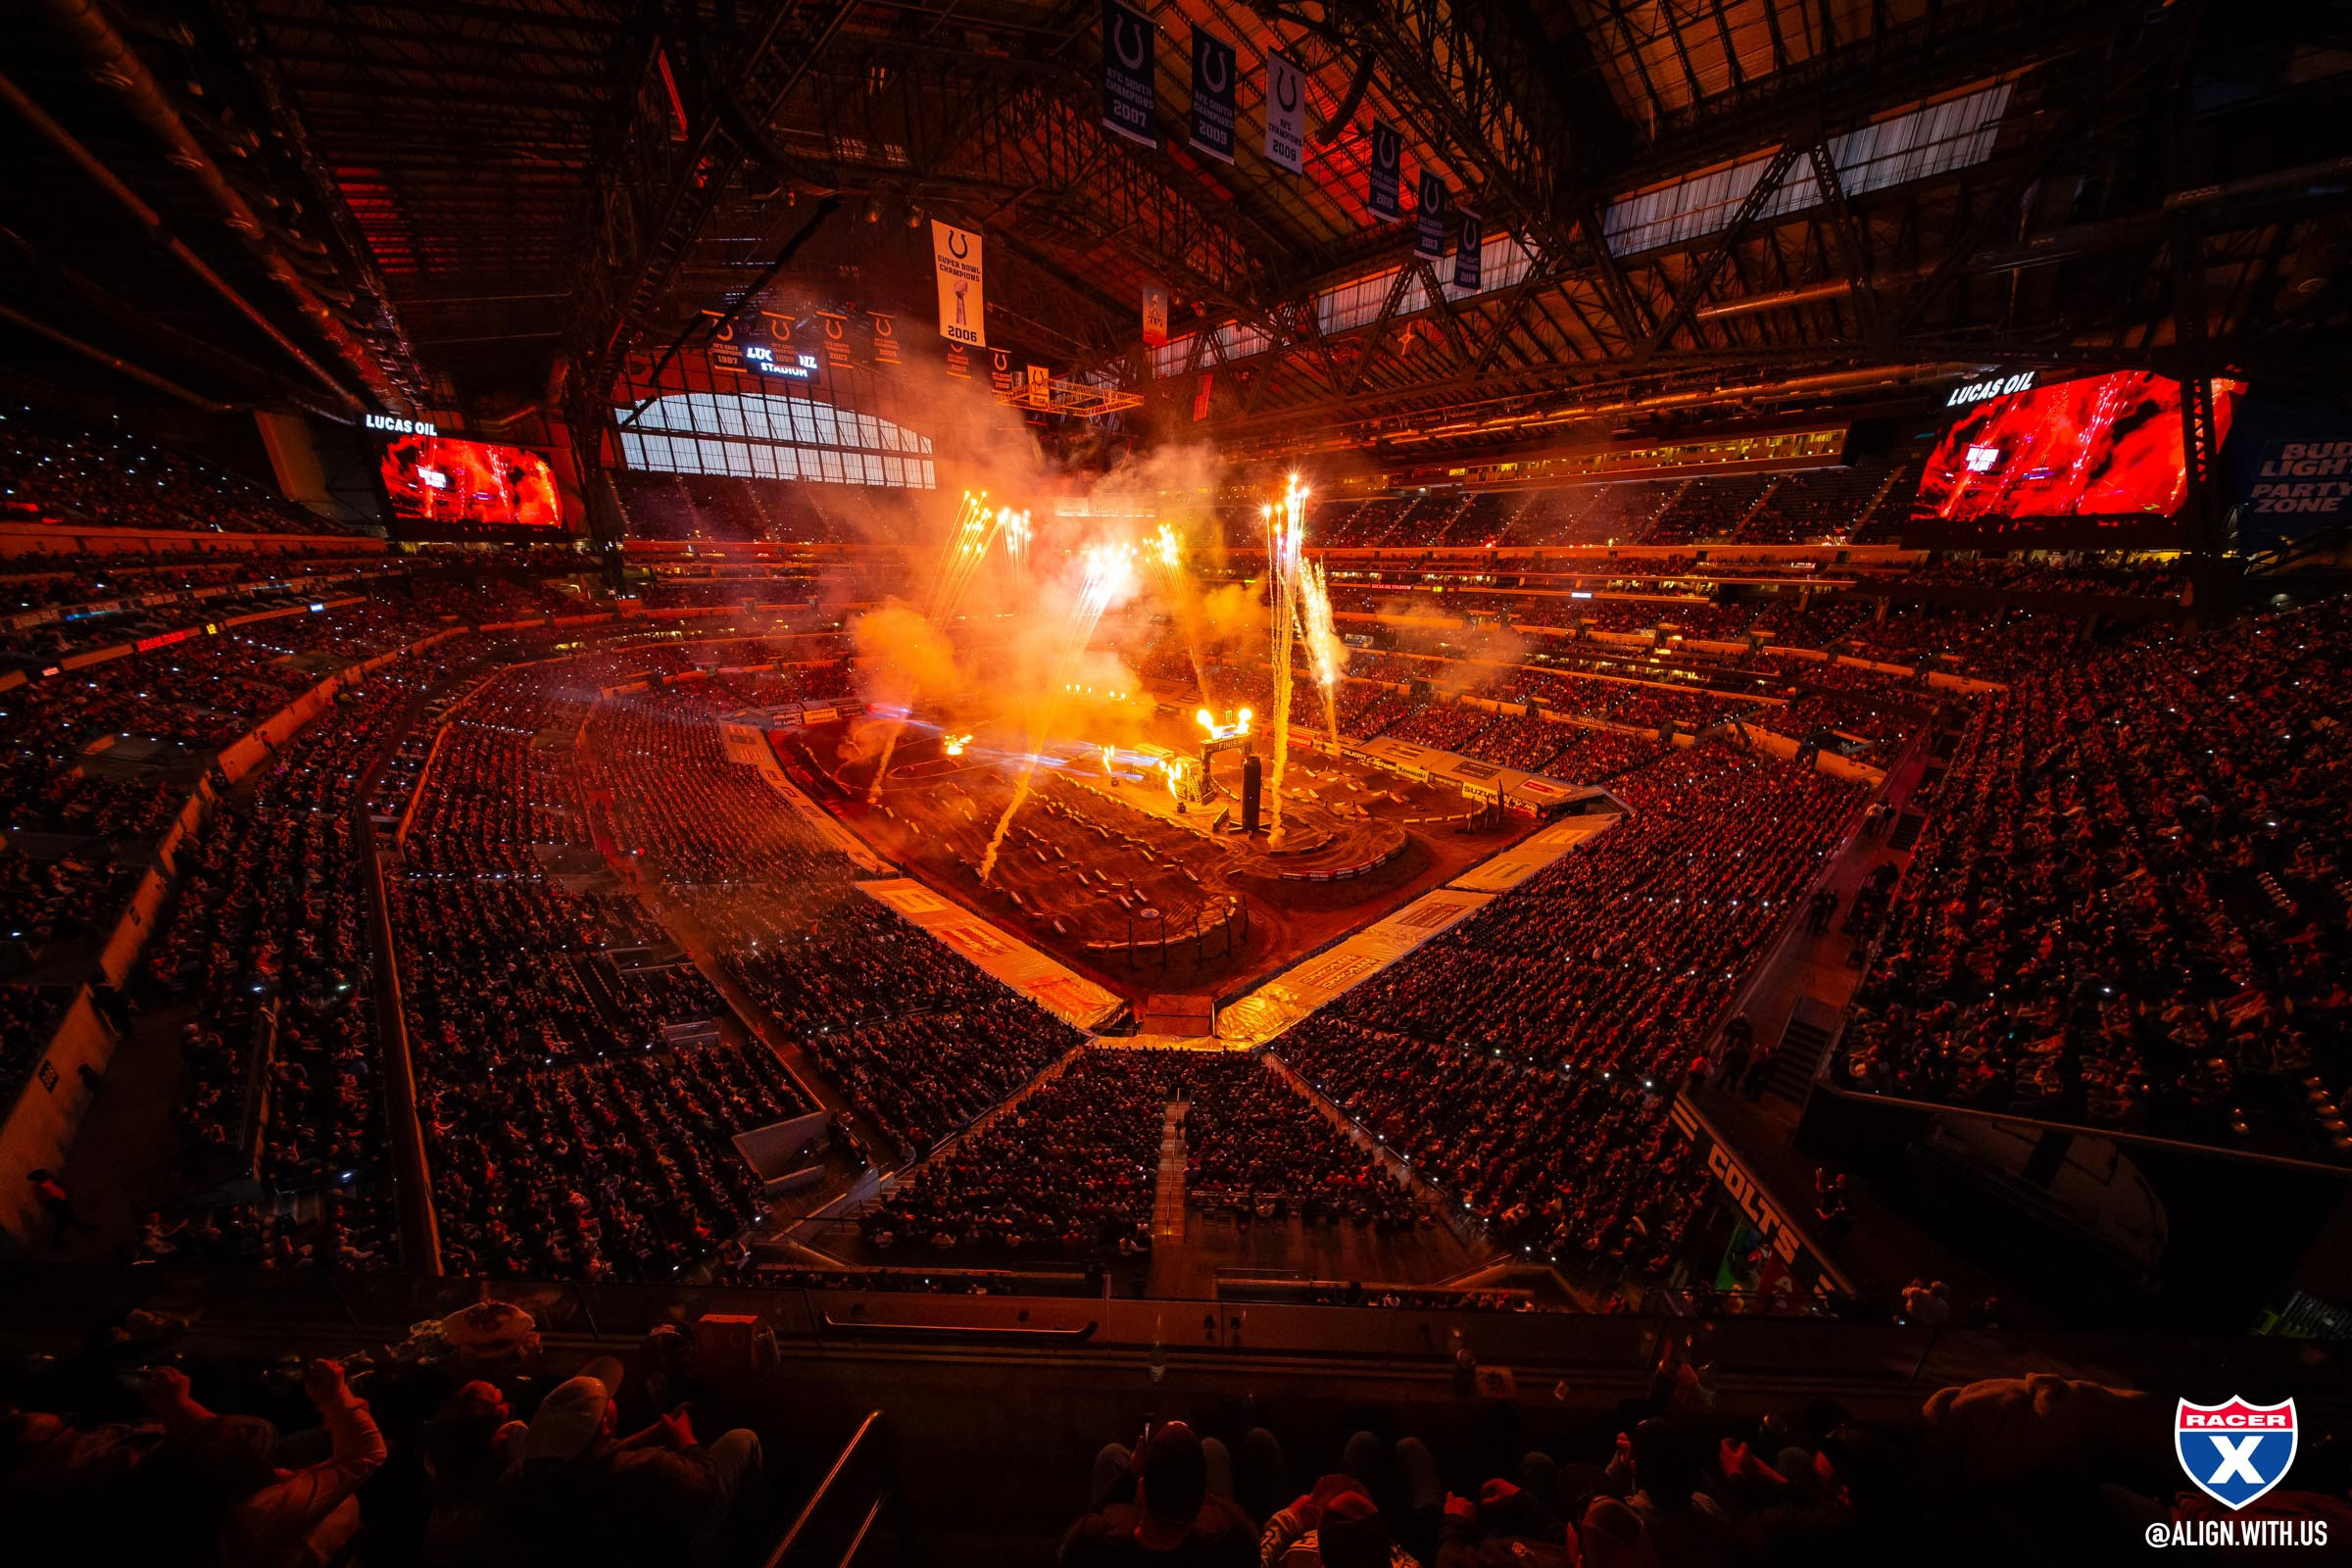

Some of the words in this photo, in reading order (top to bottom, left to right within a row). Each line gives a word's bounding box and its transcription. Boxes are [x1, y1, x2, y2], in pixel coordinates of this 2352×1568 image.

[1105, 78, 1154, 110] CHAMPIONS
[1113, 99, 1148, 128] 2007
[1194, 102, 1235, 128] CHAMPIONS
[1199, 120, 1228, 145] 2009
[1268, 122, 1302, 147] CHAMPIONS
[1279, 119, 1293, 131] AFC
[1272, 139, 1297, 161] 2009
[937, 254, 960, 269] SUPER
[961, 262, 981, 275] BOWL
[939, 263, 980, 283] CHAMPIONS
[948, 324, 978, 343] 2006
[717, 355, 738, 366] 1987
[760, 362, 808, 378] STADIUM
[1946, 380, 2001, 408] LUCAS
[2002, 370, 2036, 396] OIL
[366, 414, 414, 434] LUCAS
[415, 421, 438, 437] OIL
[2281, 441, 2352, 461] BUD
[2253, 497, 2342, 514] ZONE
[1218, 739, 1244, 751] FINISH
[1397, 765, 1427, 780] Kawasaki
[1708, 1144, 1801, 1265] COLTS
